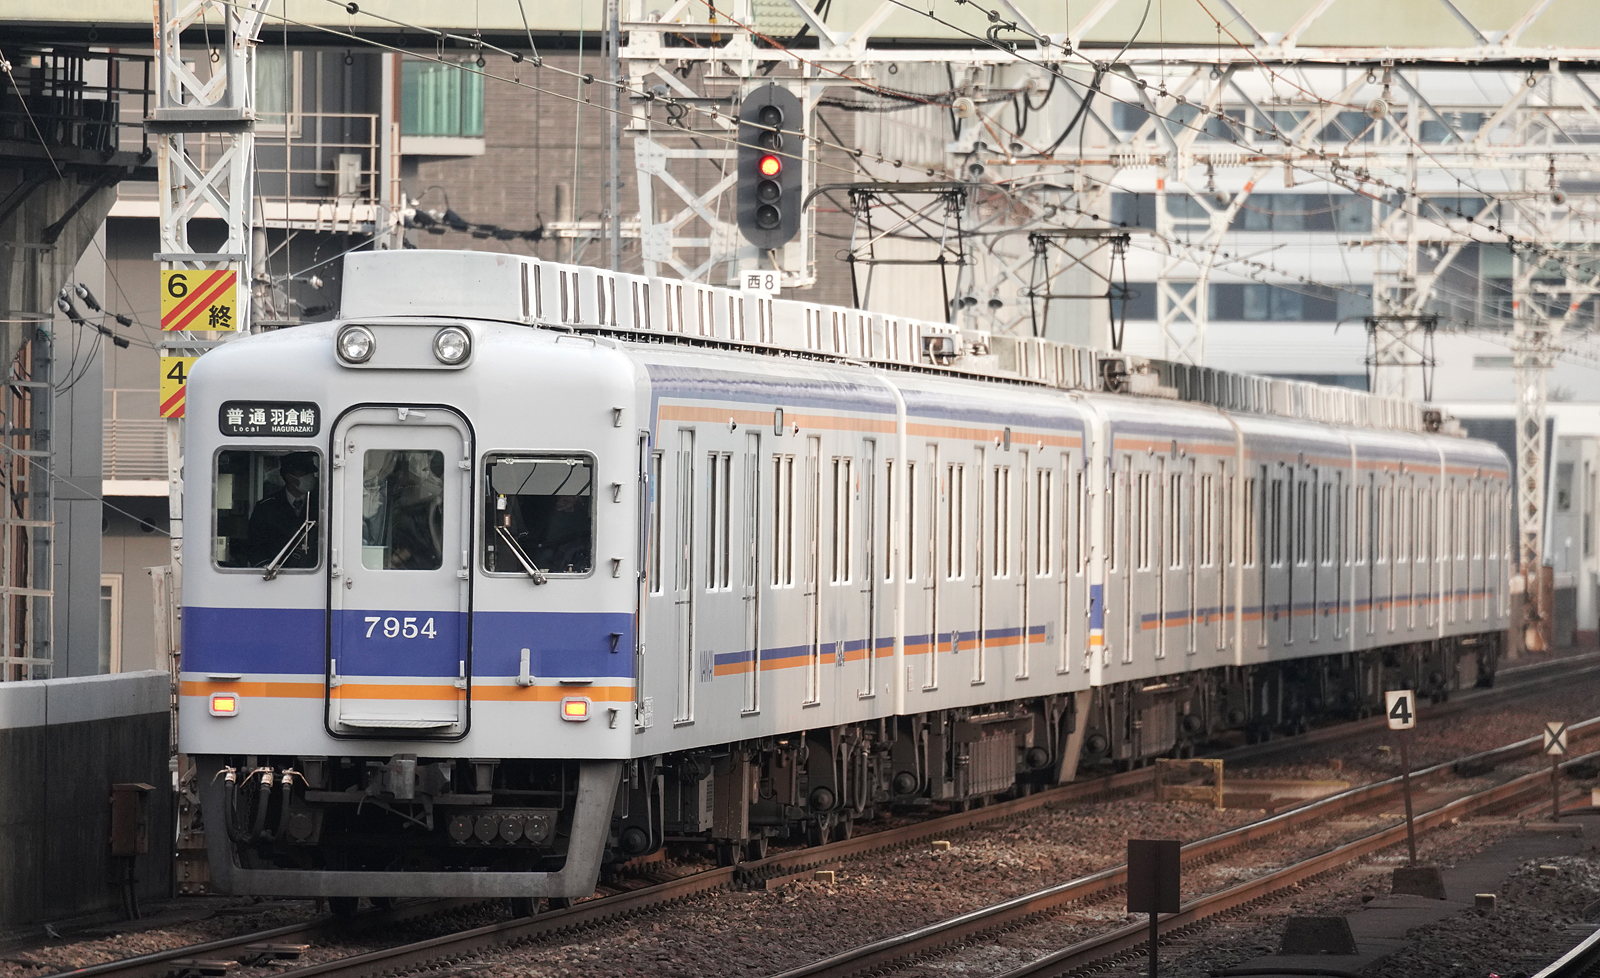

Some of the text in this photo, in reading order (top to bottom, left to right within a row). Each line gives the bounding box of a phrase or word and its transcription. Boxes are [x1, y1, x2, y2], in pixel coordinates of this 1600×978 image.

[167, 273, 188, 298] 6
[208, 305, 232, 328] 終
[166, 361, 187, 385] 4
[233, 425, 260, 433] Local
[364, 616, 437, 639] 7954
[1389, 696, 1412, 724] 4
